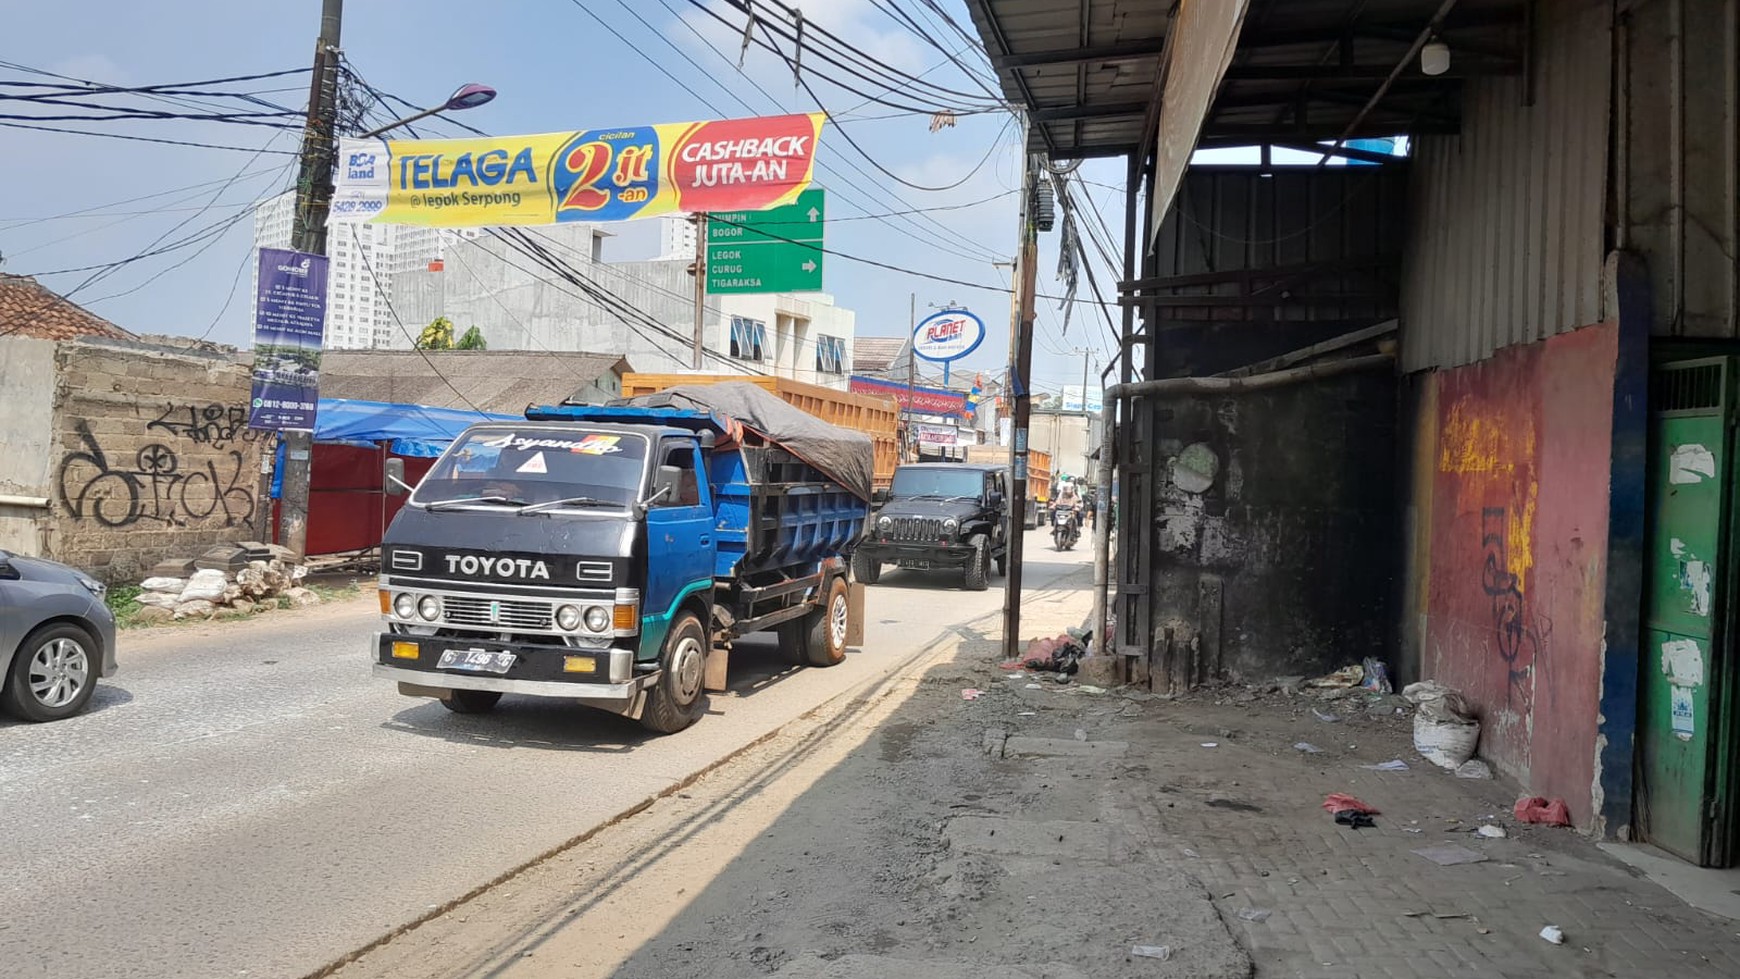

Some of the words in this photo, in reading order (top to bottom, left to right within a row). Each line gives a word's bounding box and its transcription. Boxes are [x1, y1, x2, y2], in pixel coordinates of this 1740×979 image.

[598, 132, 636, 140] cicilan
[681, 136, 810, 162] CASHBACK
[347, 167, 375, 179] land
[398, 147, 538, 190] TELAGA
[558, 141, 613, 211] 2
[612, 144, 653, 187] jt
[692, 160, 788, 188] JUTA-AN
[422, 193, 460, 209] legok
[461, 191, 521, 208] Serpong
[712, 227, 743, 237] BOGOR
[711, 250, 741, 260] LEGOK
[711, 265, 742, 274] CURUG
[711, 278, 762, 288] TIGARAKSA
[927, 319, 966, 340] PLANET
[445, 555, 550, 580] TOYOTA
